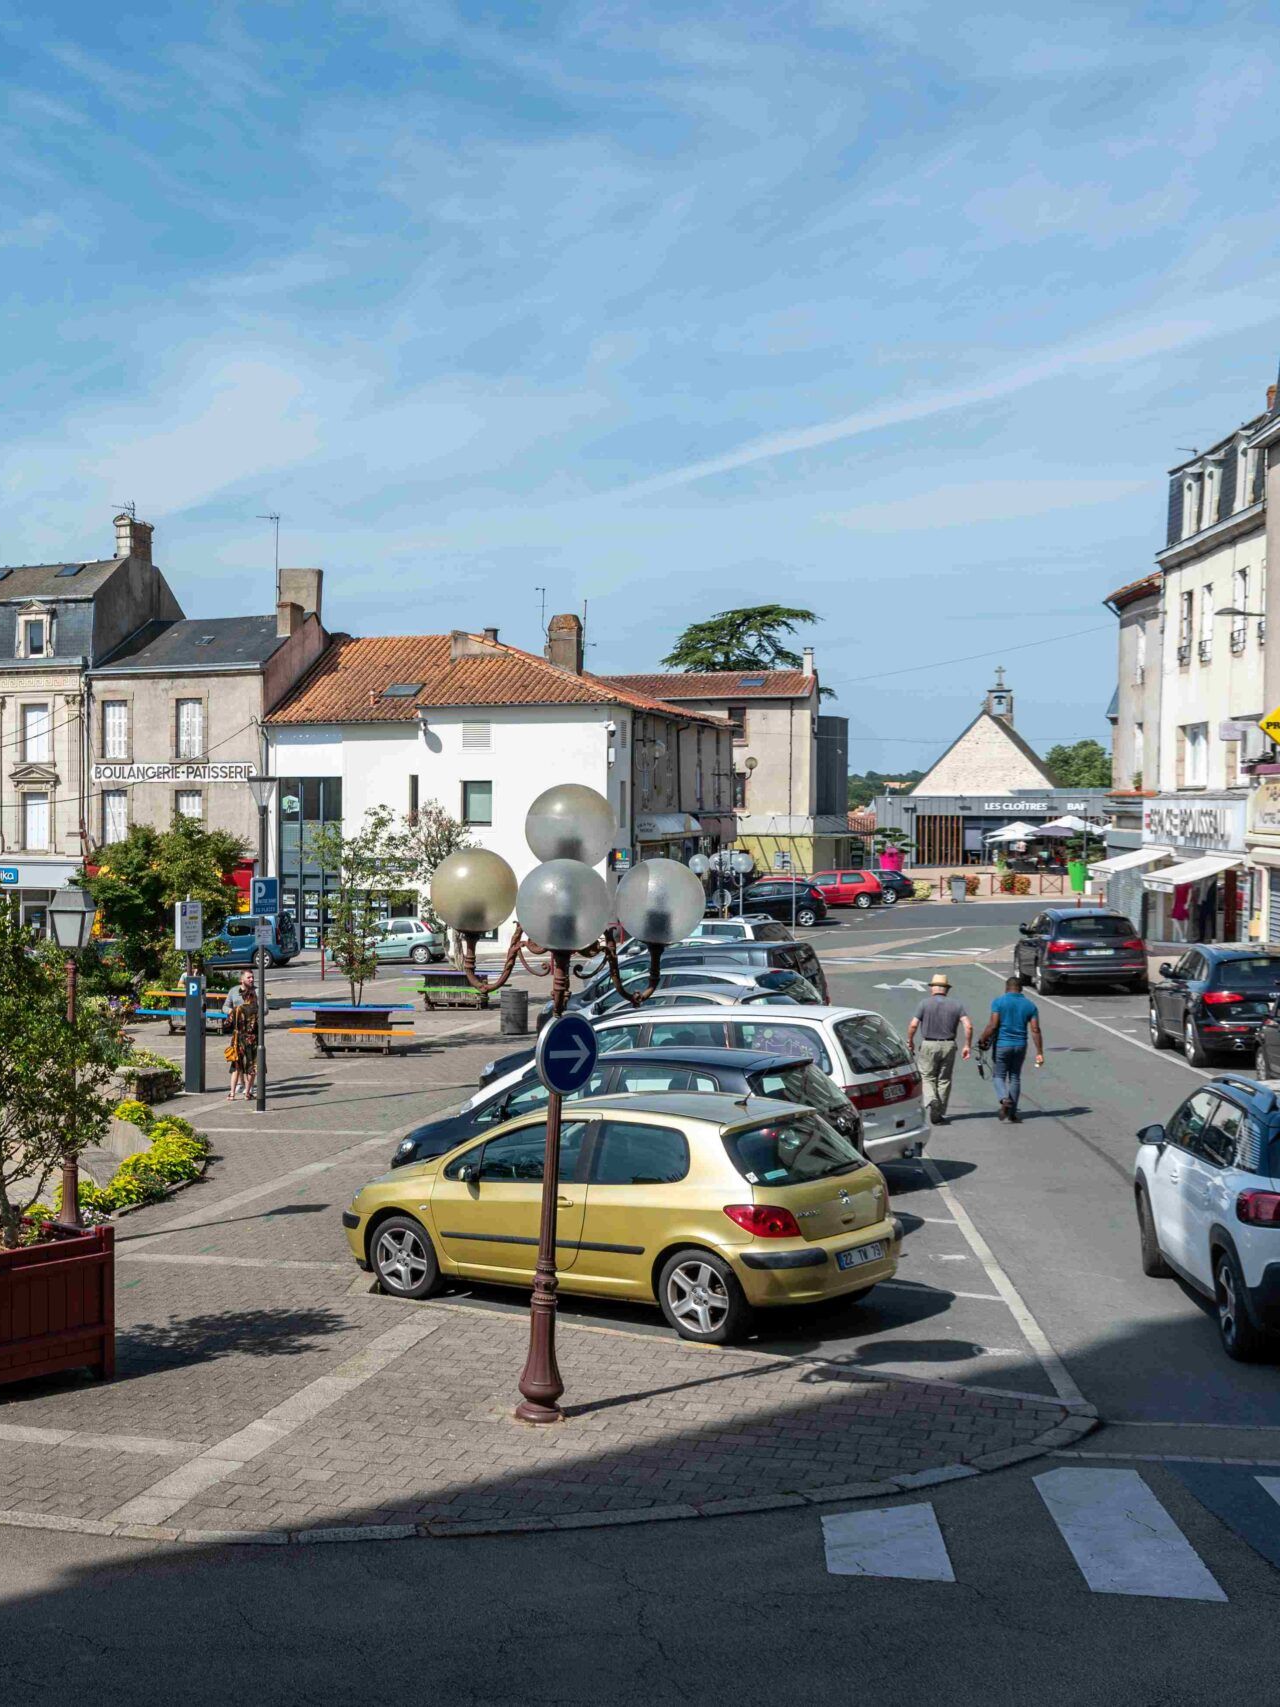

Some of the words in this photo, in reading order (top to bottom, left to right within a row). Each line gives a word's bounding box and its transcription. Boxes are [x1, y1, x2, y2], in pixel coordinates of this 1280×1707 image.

[984, 802, 1000, 811] LES
[1002, 801, 1048, 811] CLOÎTRES
[255, 882, 266, 904] P
[189, 982, 198, 995] P
[843, 1252, 855, 1266] 22
[870, 1244, 882, 1257] 79
